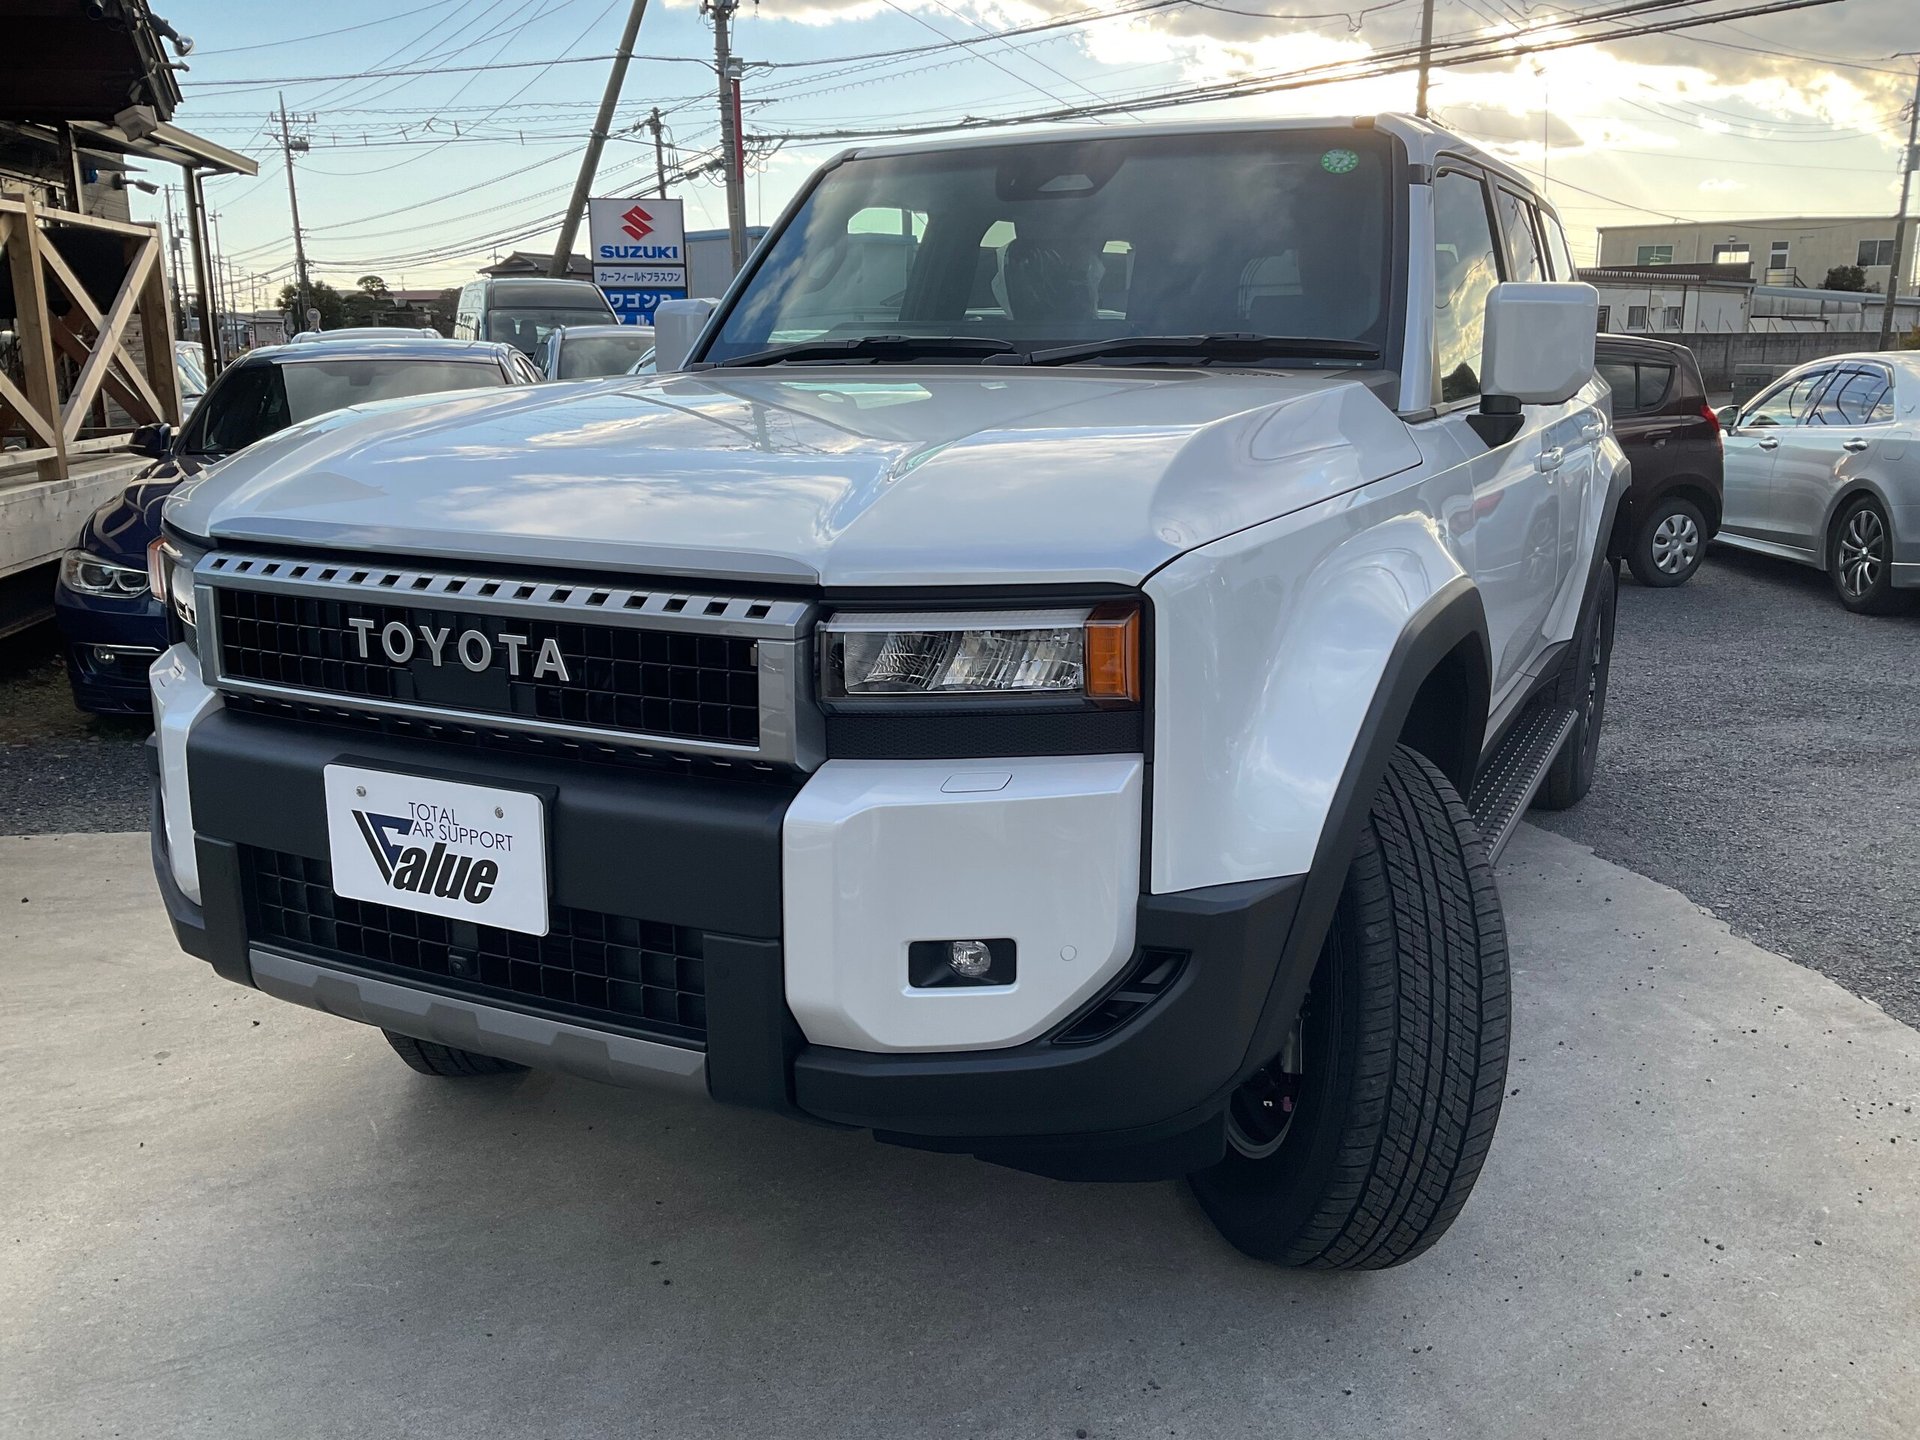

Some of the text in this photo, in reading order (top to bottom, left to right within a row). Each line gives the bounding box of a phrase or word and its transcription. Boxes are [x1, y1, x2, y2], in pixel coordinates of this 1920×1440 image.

[600, 245, 678, 259] SUZUKI
[348, 617, 569, 682] TOYOTA
[408, 802, 459, 826] TOTAL
[439, 824, 513, 852] SUPPORT
